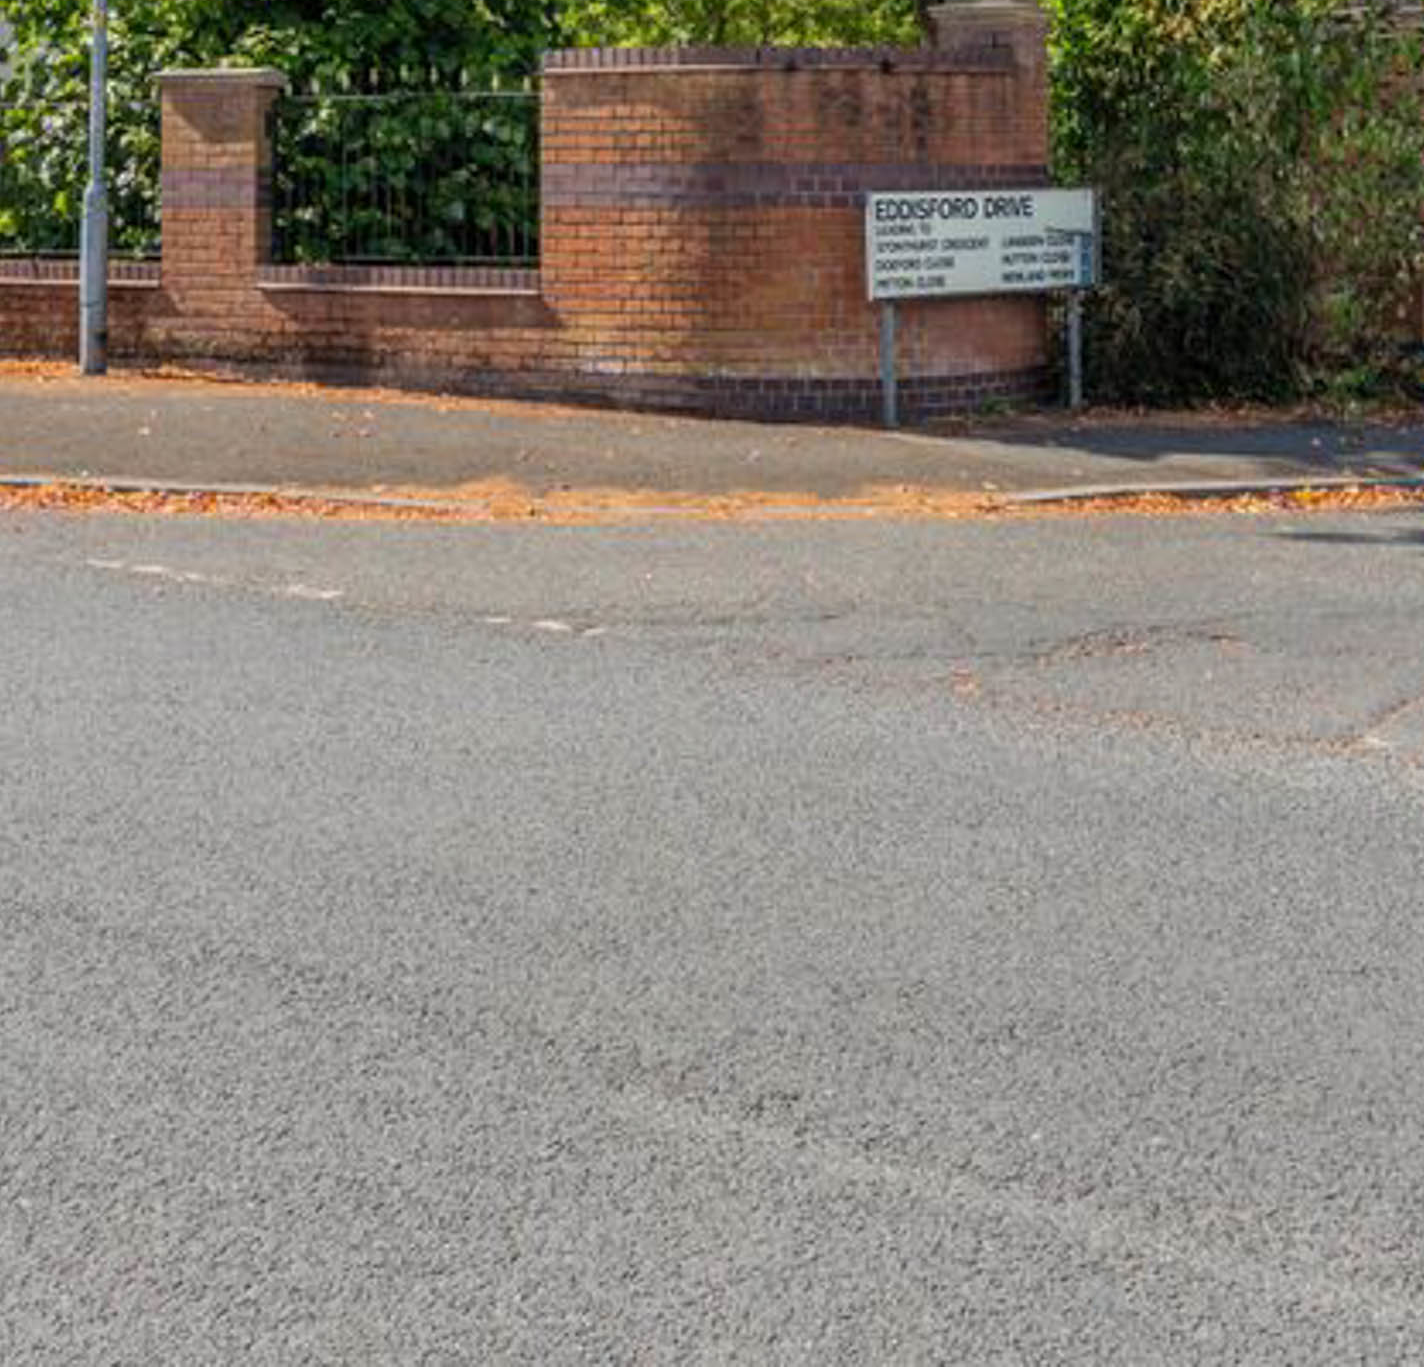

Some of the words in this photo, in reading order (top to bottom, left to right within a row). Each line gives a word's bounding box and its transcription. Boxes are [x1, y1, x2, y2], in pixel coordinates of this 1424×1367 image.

[984, 195, 1034, 219] DRIVE
[939, 237, 989, 251] CRESCENT
[924, 255, 955, 270] CLOSE
[1042, 250, 1070, 264] CLOSE
[917, 274, 945, 288] CLOSE
